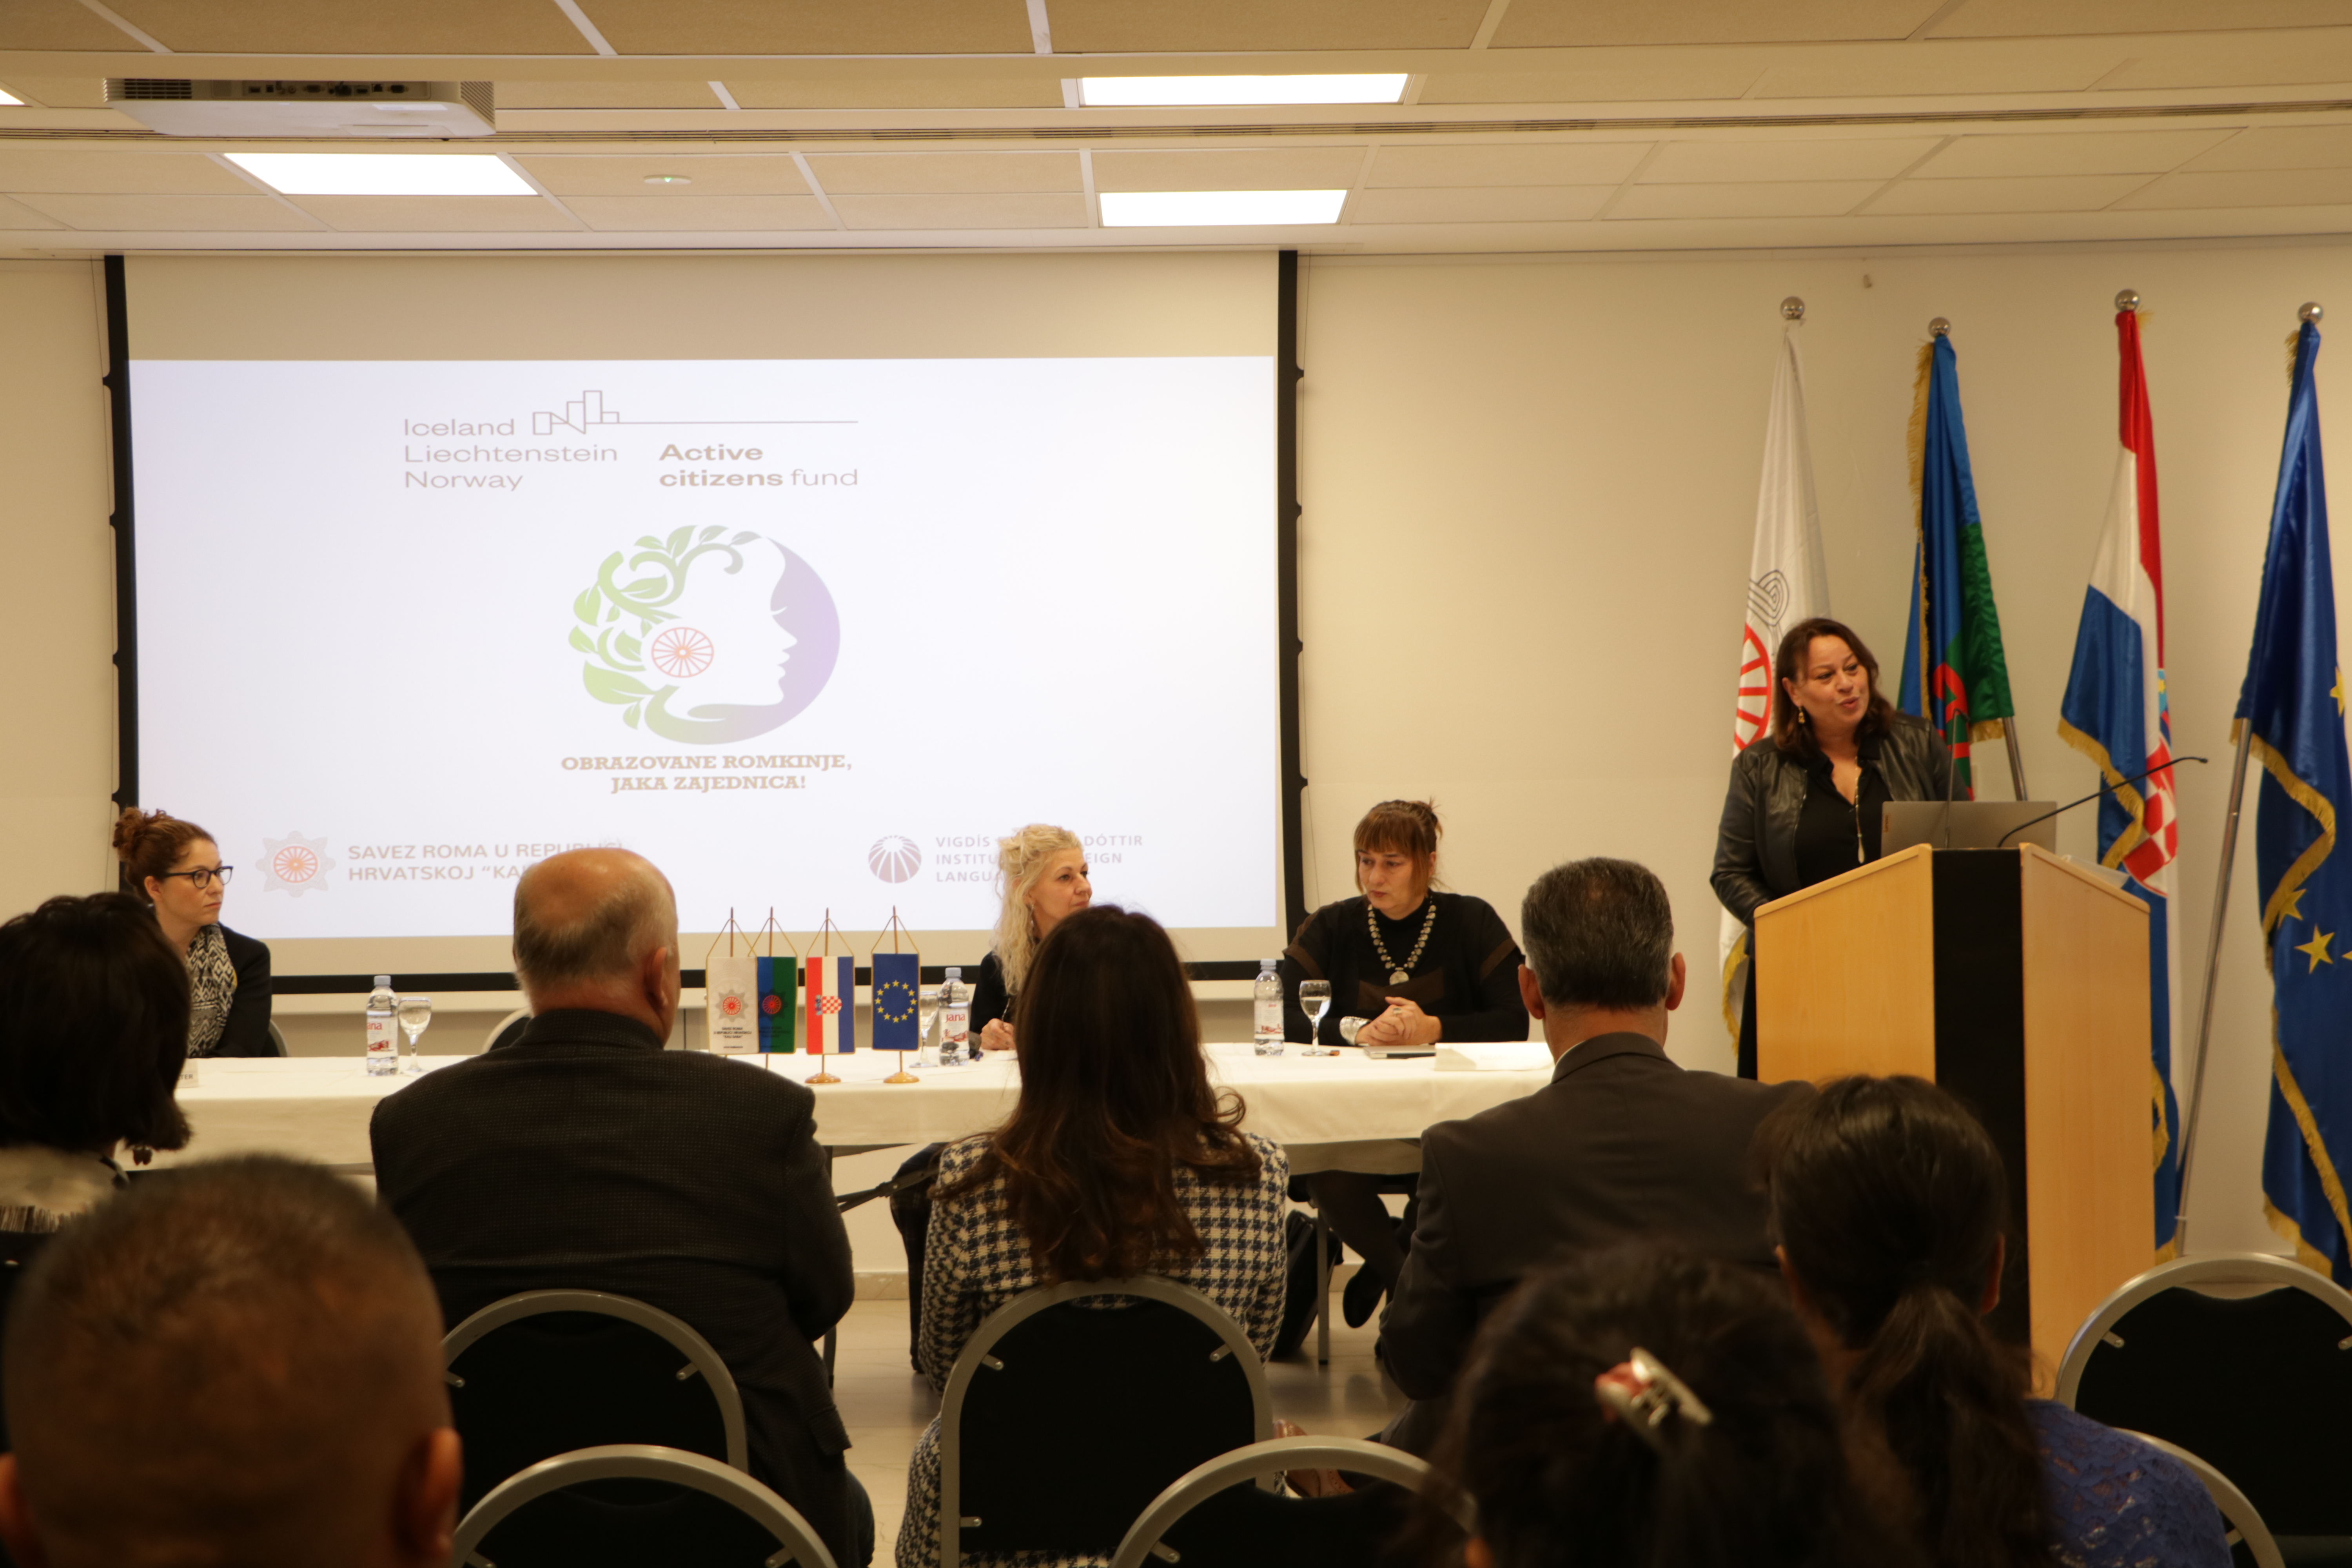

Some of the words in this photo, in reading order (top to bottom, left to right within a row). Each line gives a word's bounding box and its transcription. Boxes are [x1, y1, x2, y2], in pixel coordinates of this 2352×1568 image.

[405, 419, 514, 436] Iceland
[405, 445, 617, 463] Liechtenstein
[659, 444, 763, 461] Active
[405, 471, 523, 492] Norway
[659, 470, 783, 487] citizens
[791, 468, 857, 486] fund
[561, 756, 717, 770] OBRAZOVANE
[722, 755, 851, 771] ROMKINJE,
[611, 777, 668, 794] JAKA
[674, 775, 806, 793] ZAJEDNICA!
[936, 835, 990, 848] VIGDÍS
[348, 845, 416, 860] SAVEZ
[423, 845, 488, 858] ROMA
[495, 844, 508, 858] U
[348, 866, 473, 881] HRVATSKOJ
